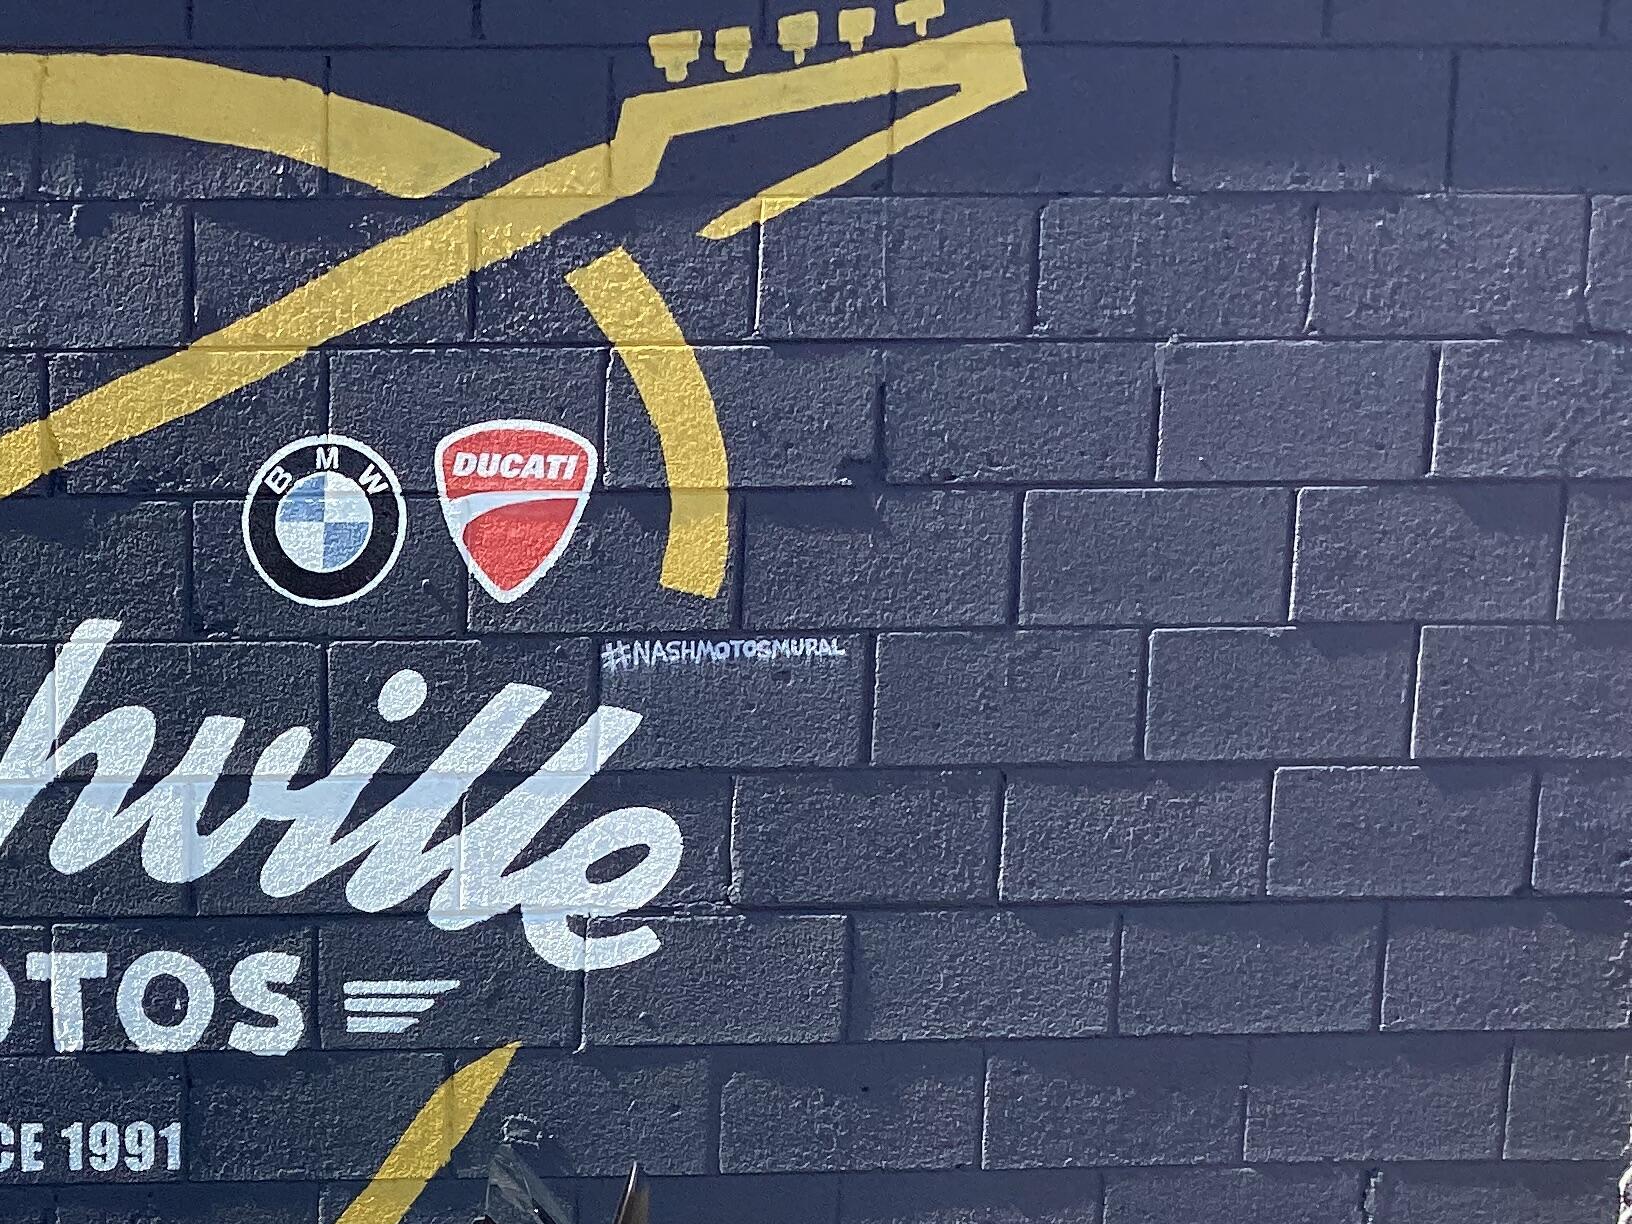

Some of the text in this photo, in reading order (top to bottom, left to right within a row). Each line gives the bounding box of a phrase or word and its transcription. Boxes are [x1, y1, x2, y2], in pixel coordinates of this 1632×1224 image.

[264, 446, 390, 496] BMW
[452, 451, 578, 480] DUCATI
[600, 637, 846, 671] #NASHMOTOSMURAL
[59, 1122, 184, 1173] 1991
